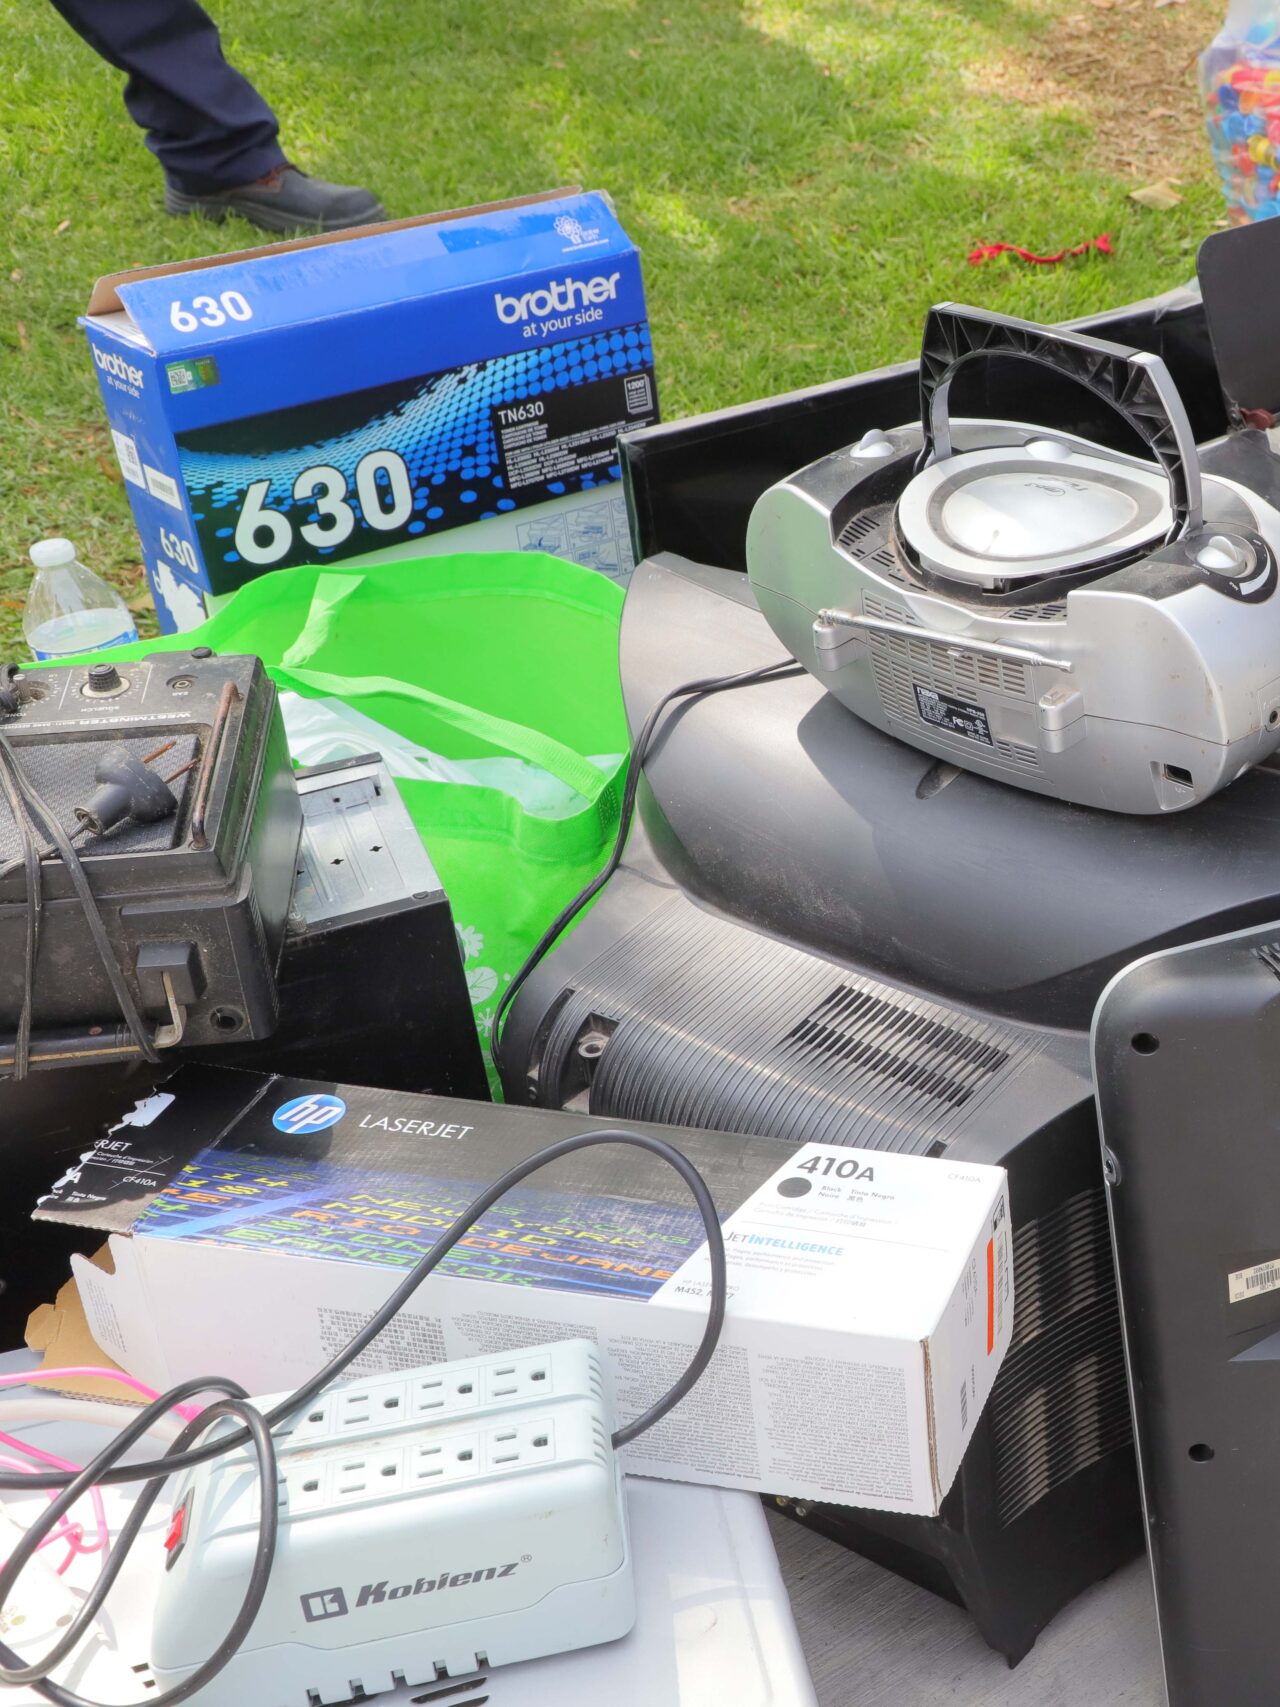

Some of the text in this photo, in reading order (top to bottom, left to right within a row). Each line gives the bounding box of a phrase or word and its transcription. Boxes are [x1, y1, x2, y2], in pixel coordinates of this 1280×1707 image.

[170, 291, 253, 333] 630
[494, 272, 620, 324] brother
[522, 307, 603, 338] at your side
[91, 342, 144, 389] brother
[498, 401, 545, 425] TN630
[235, 448, 413, 566] 630
[160, 527, 199, 574] 630
[79, 712, 191, 726] WESTMINSTER
[278, 1094, 343, 1134] hp
[358, 1114, 474, 1140] LASERJET
[122, 1176, 158, 1187] CF410A
[797, 1155, 875, 1183] 410A
[821, 1185, 842, 1193] Black
[291, 1209, 421, 1236] RIO
[320, 1202, 560, 1246] MADRID
[349, 1194, 648, 1248] NEW YORK
[257, 1219, 522, 1266] SYDNEY
[355, 1562, 519, 1608] Koblenz
